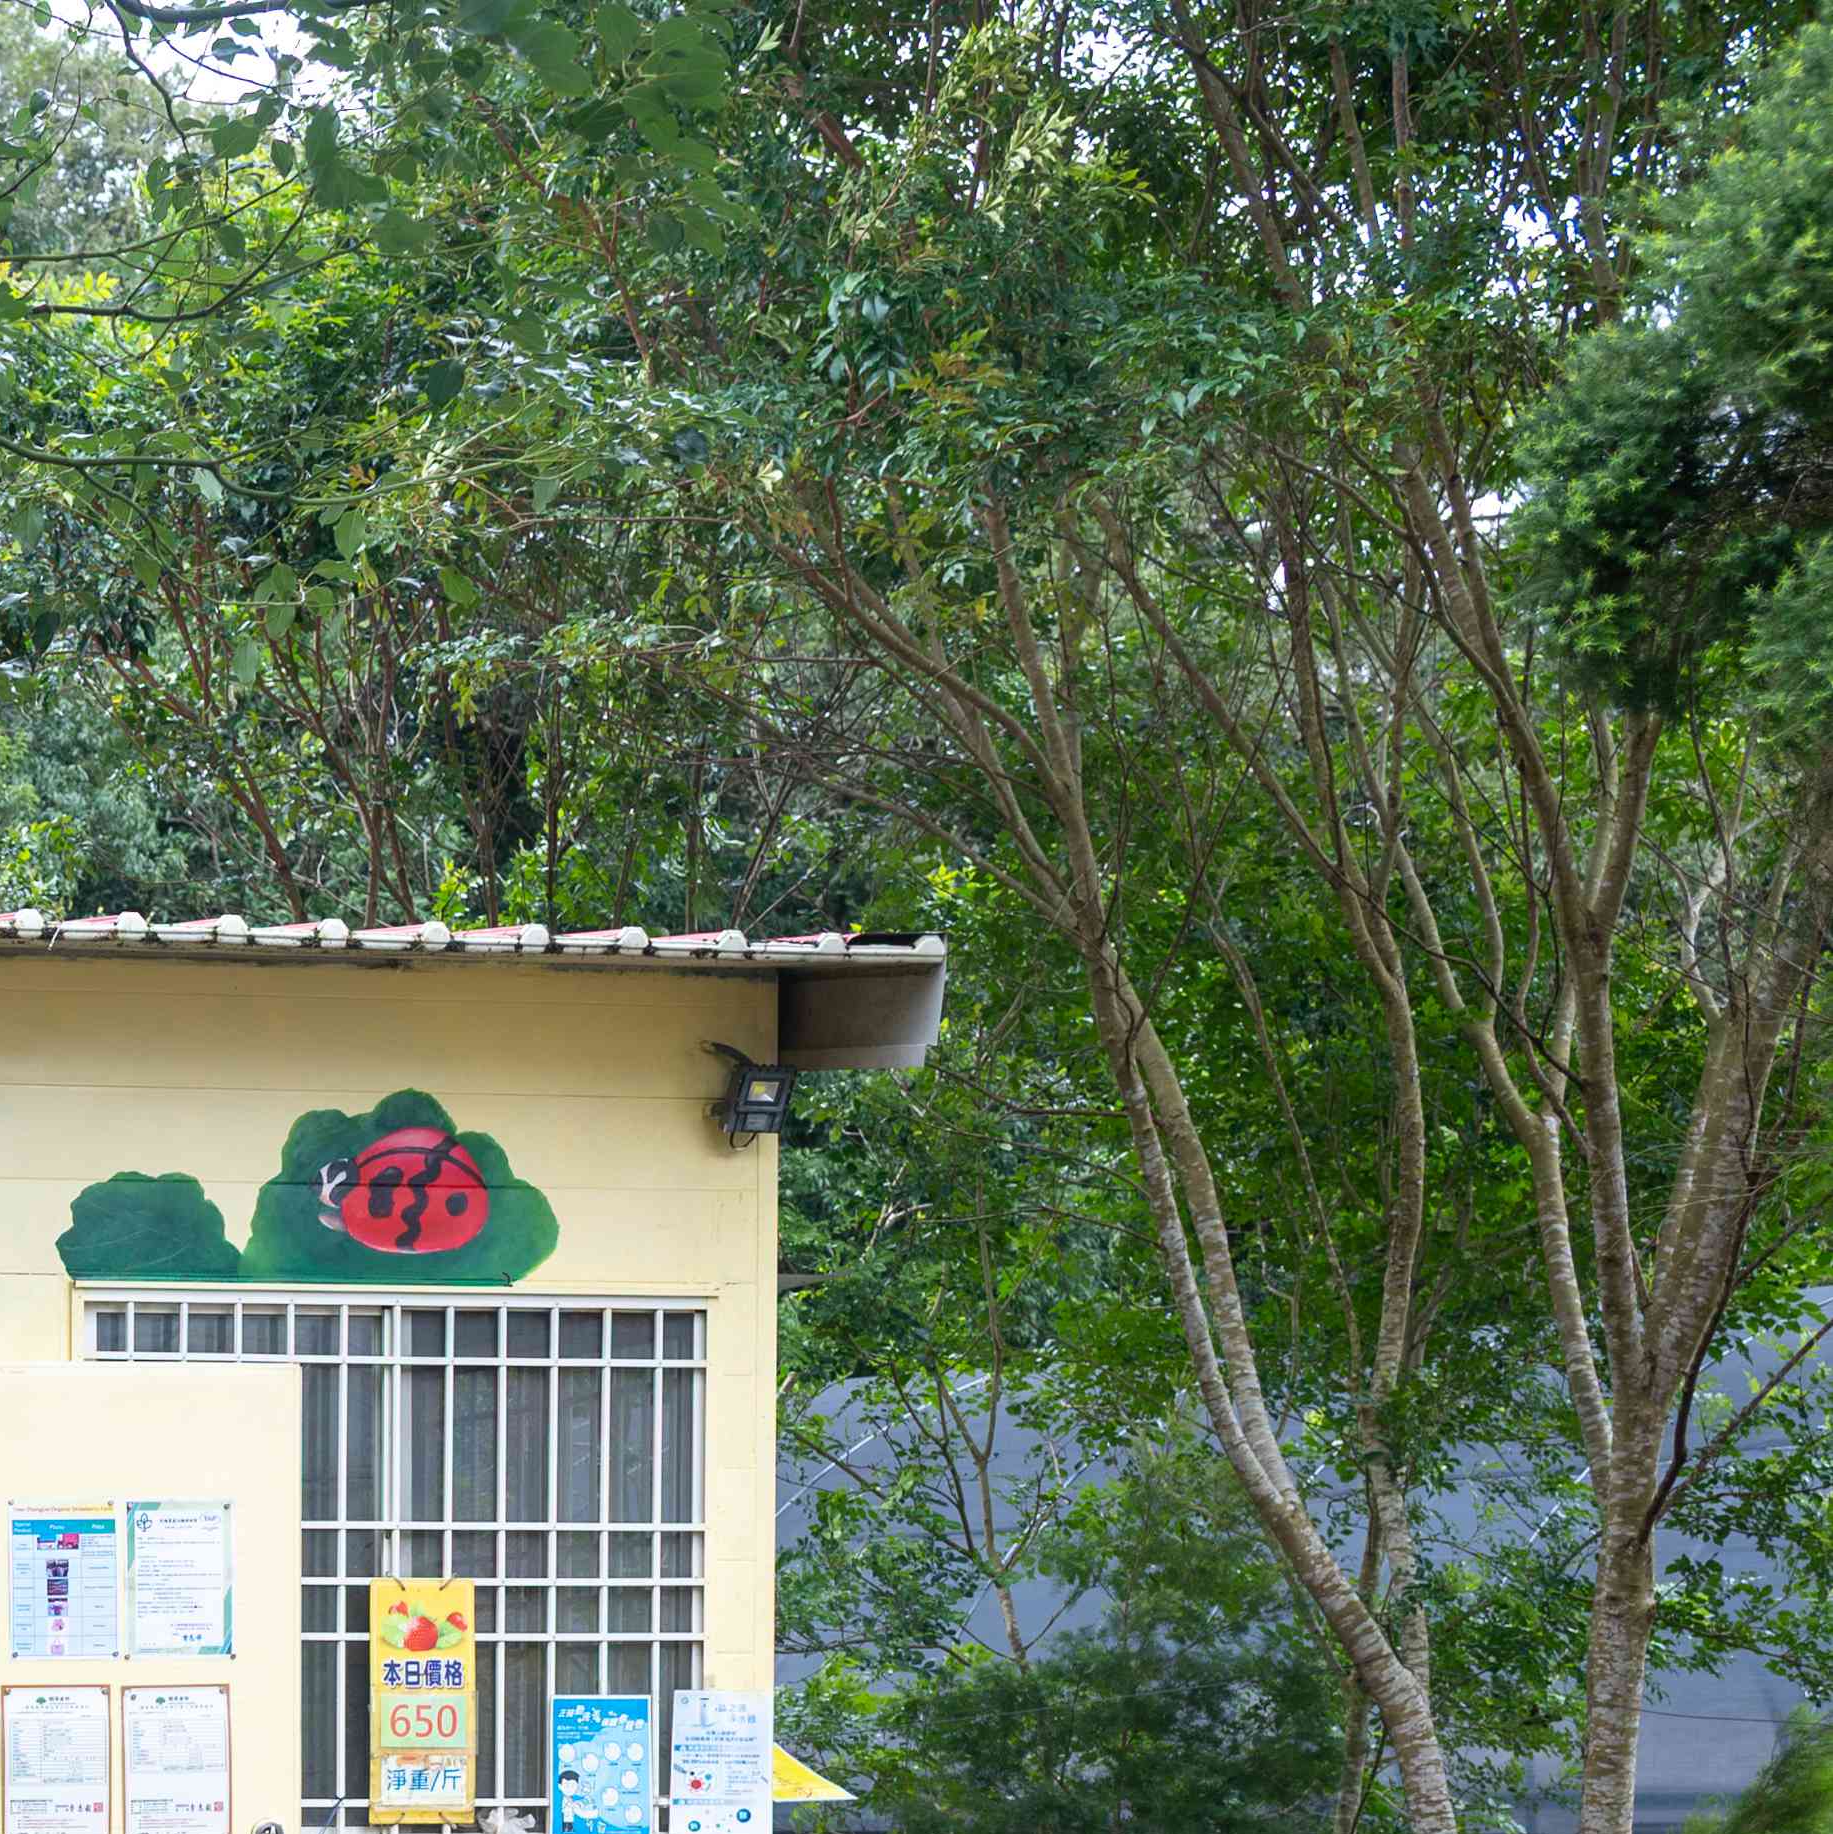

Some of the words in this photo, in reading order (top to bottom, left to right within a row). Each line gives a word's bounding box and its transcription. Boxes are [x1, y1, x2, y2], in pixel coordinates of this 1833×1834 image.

[383, 1659, 464, 1689] 本日價格
[389, 1704, 459, 1738] 650
[386, 1768, 462, 1792] 淨重/斤
